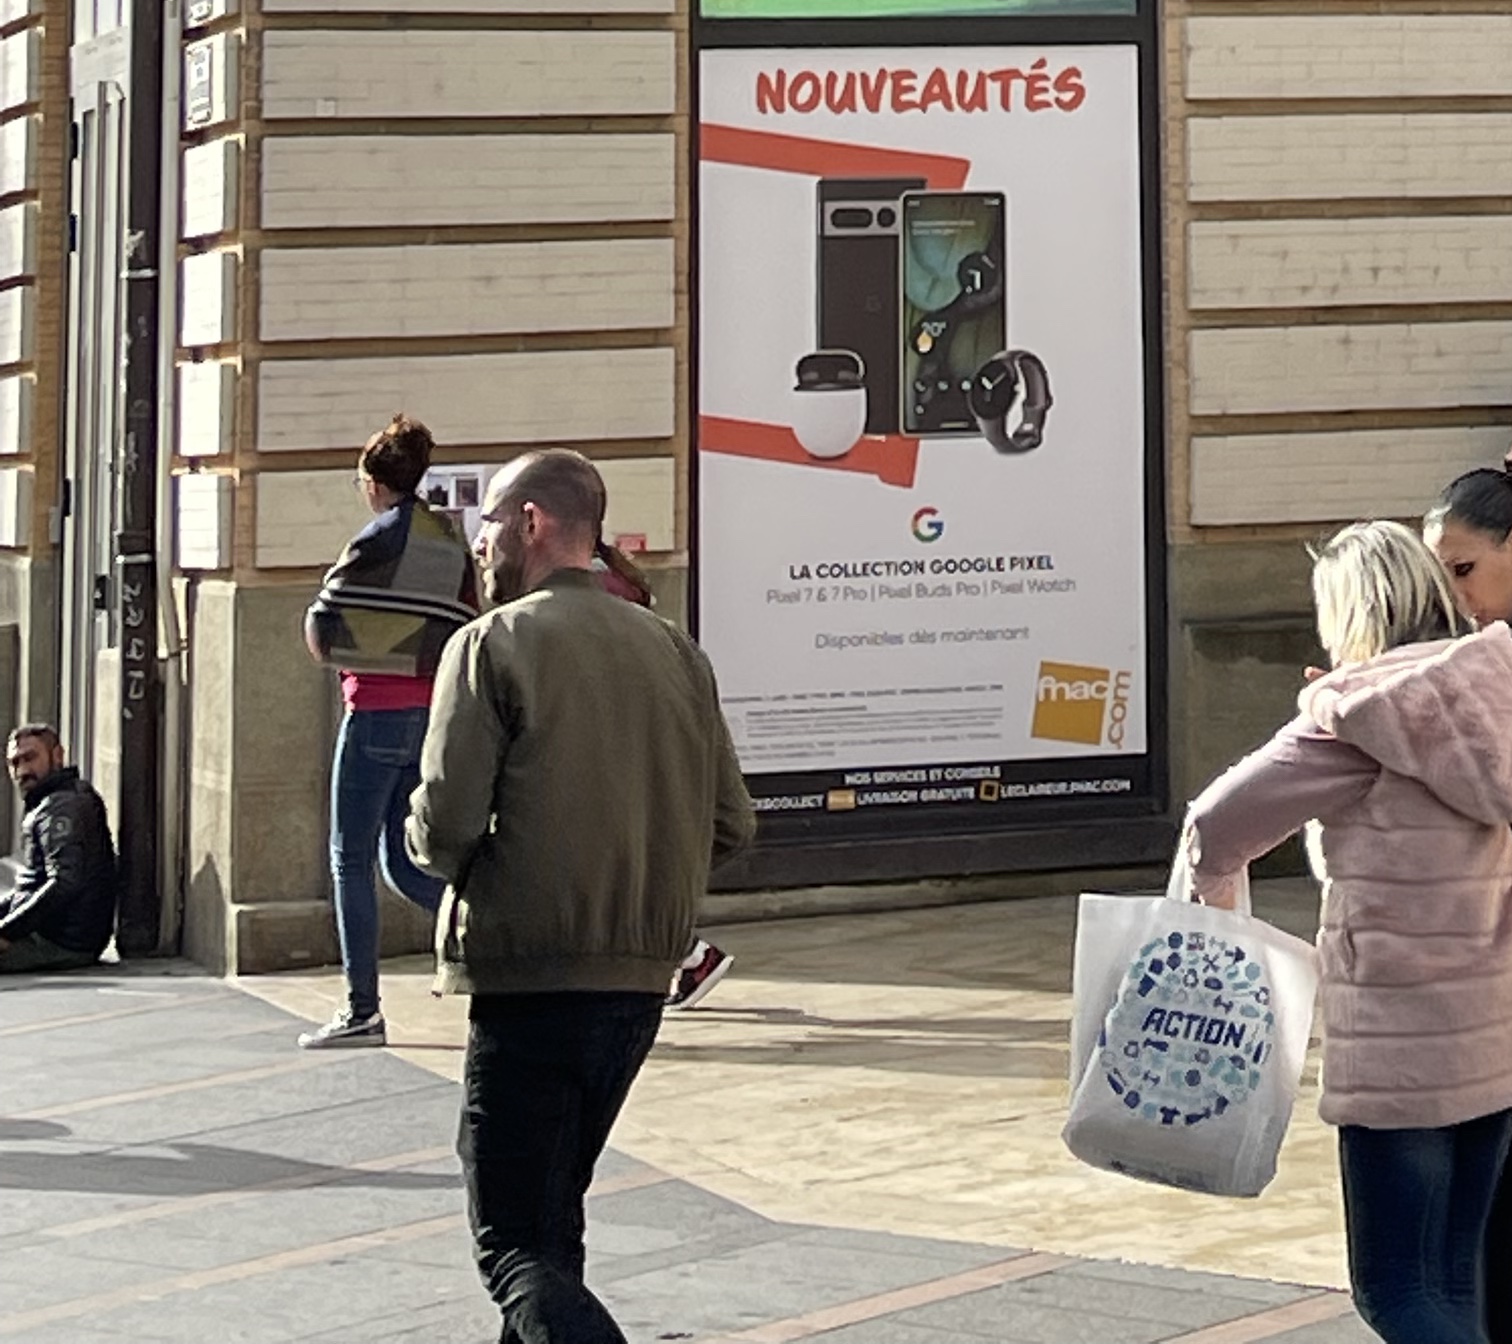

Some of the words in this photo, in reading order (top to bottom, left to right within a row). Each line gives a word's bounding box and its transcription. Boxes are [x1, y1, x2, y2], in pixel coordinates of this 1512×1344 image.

[756, 58, 1086, 114] NOUVEAUTÉS
[912, 506, 944, 543] G
[789, 564, 811, 580] LA
[815, 560, 925, 579] COLLECTION
[930, 557, 1005, 576] GOOGLE
[1010, 555, 1054, 571] PIXEL
[766, 588, 802, 604] Pixel
[804, 588, 813, 602] 7
[832, 587, 840, 601] 7
[843, 586, 868, 601] Pro
[879, 583, 912, 599] Pixel
[915, 583, 952, 598] Buds
[956, 582, 981, 596] Pro
[991, 579, 1023, 595] Pixel
[1027, 578, 1076, 593] Watch
[815, 632, 904, 649] Disponibles
[909, 629, 937, 644] dès
[941, 626, 1029, 643] maintenant
[1039, 675, 1108, 702] fnac
[1141, 1007, 1246, 1049] ACTION
